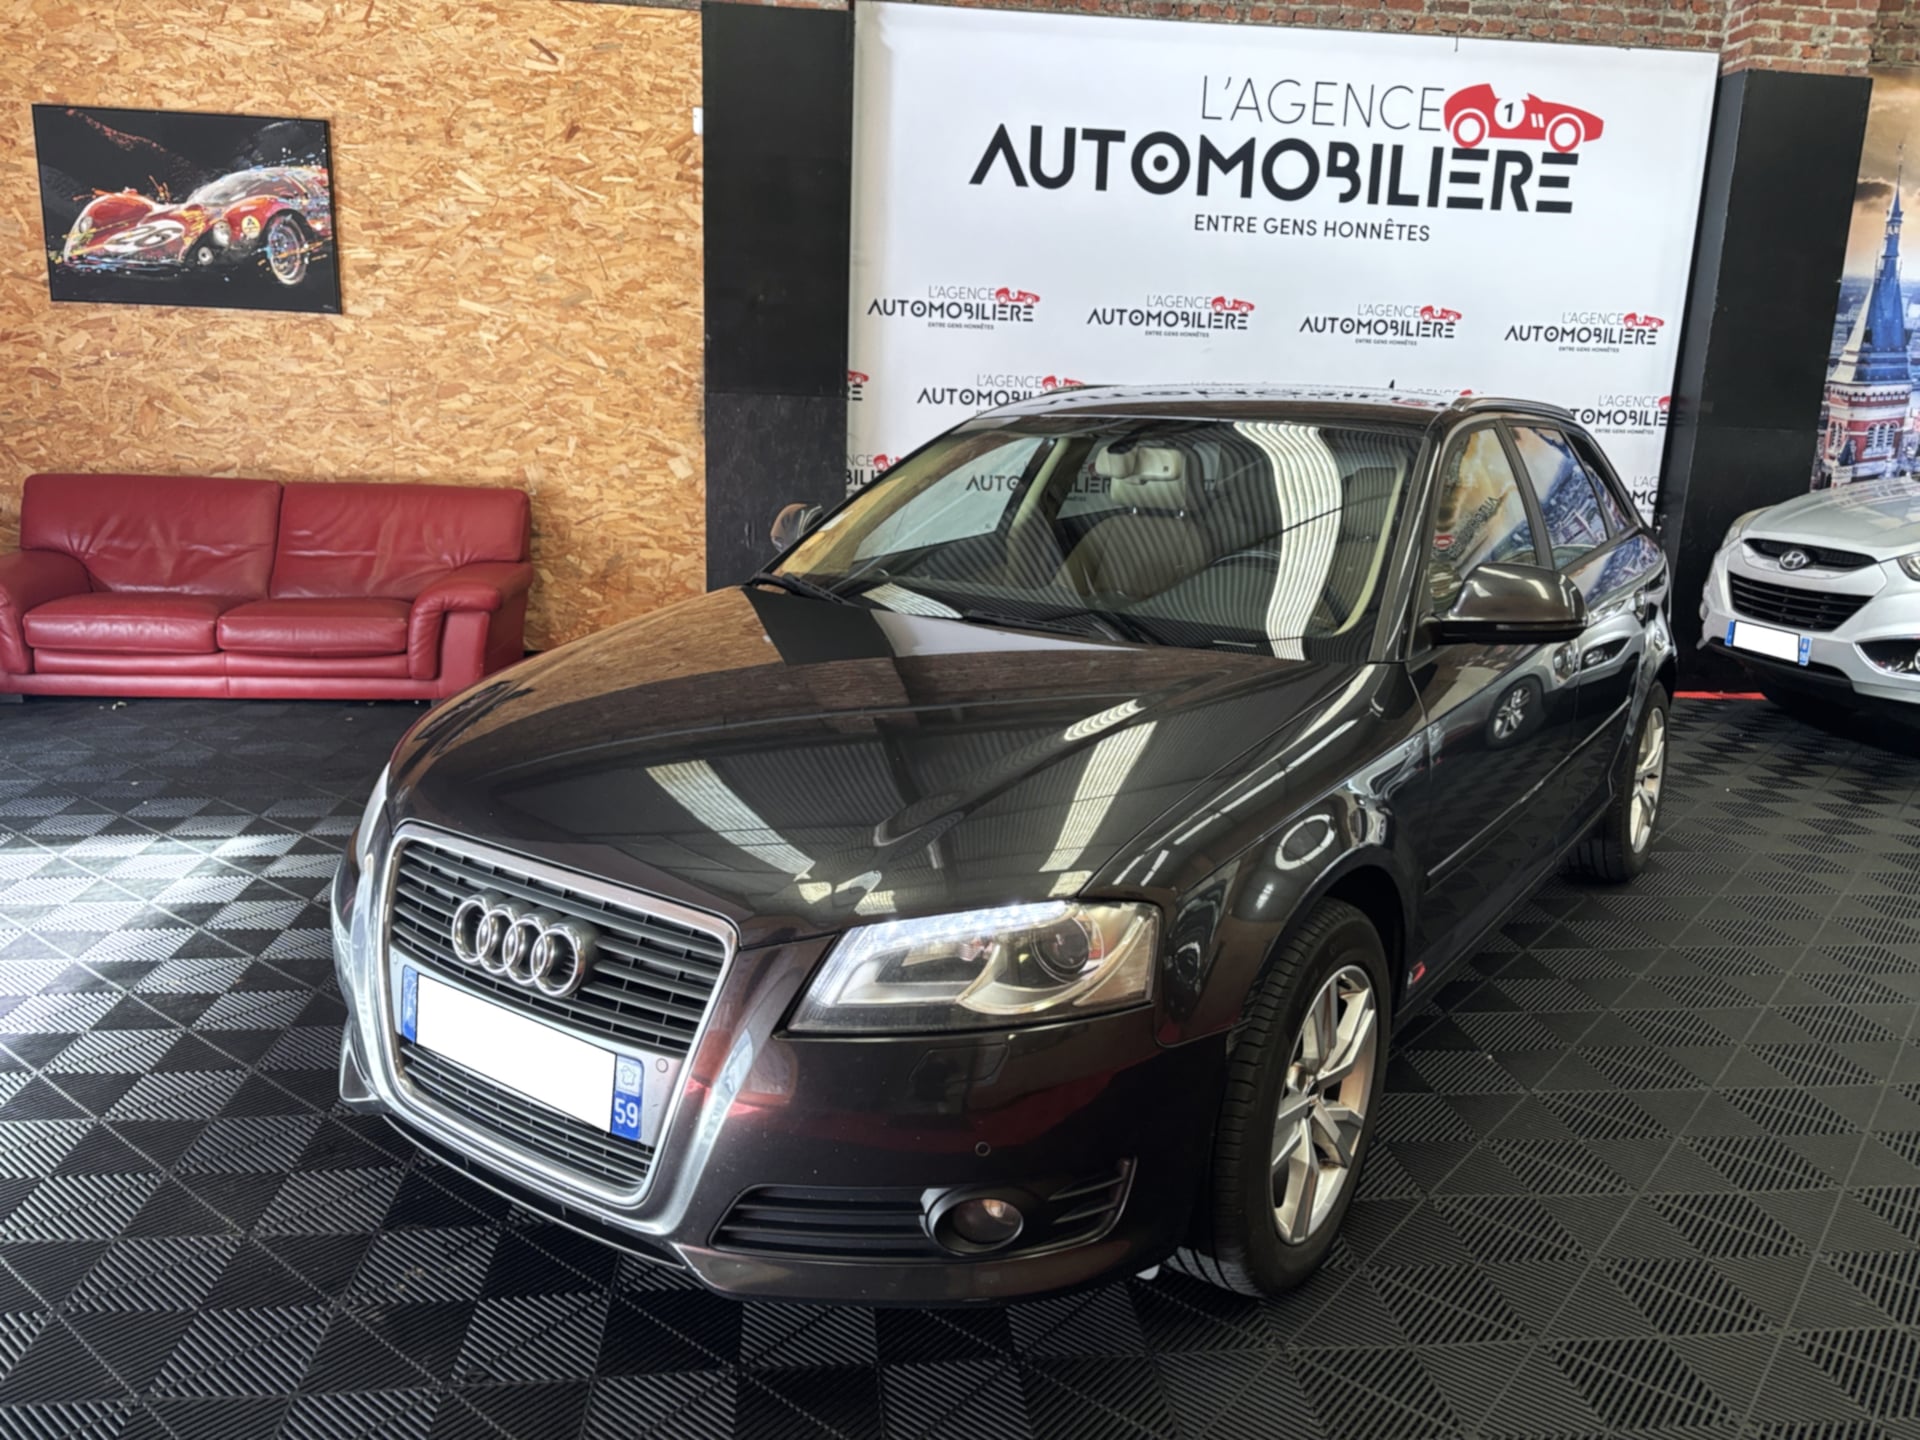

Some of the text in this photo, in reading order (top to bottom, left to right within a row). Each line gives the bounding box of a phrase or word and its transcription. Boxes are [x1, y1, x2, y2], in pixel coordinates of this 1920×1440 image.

[1201, 74, 1445, 132] L'AGENCE
[1503, 102, 1515, 123] 1
[969, 123, 1579, 214] AUTOMOBILIERE
[1194, 214, 1431, 242] ENTRE GENS HONNÊTES
[928, 285, 996, 301] L'AGENCE
[1146, 294, 1211, 310] L'AGENCE
[867, 298, 1034, 322] AUTOMOBILIERE
[1086, 307, 1249, 330] AUTOMOBILIERE
[1357, 303, 1421, 318] L'AGENCE
[1562, 312, 1624, 326] L'AGENCE
[1299, 316, 1455, 339] AUTOMOBILIERE
[1504, 325, 1658, 345] AUTOMOBILIERE
[976, 374, 1043, 389] L'AGENCE
[1598, 395, 1658, 408] L'AGENCE
[614, 1099, 638, 1128] 59
